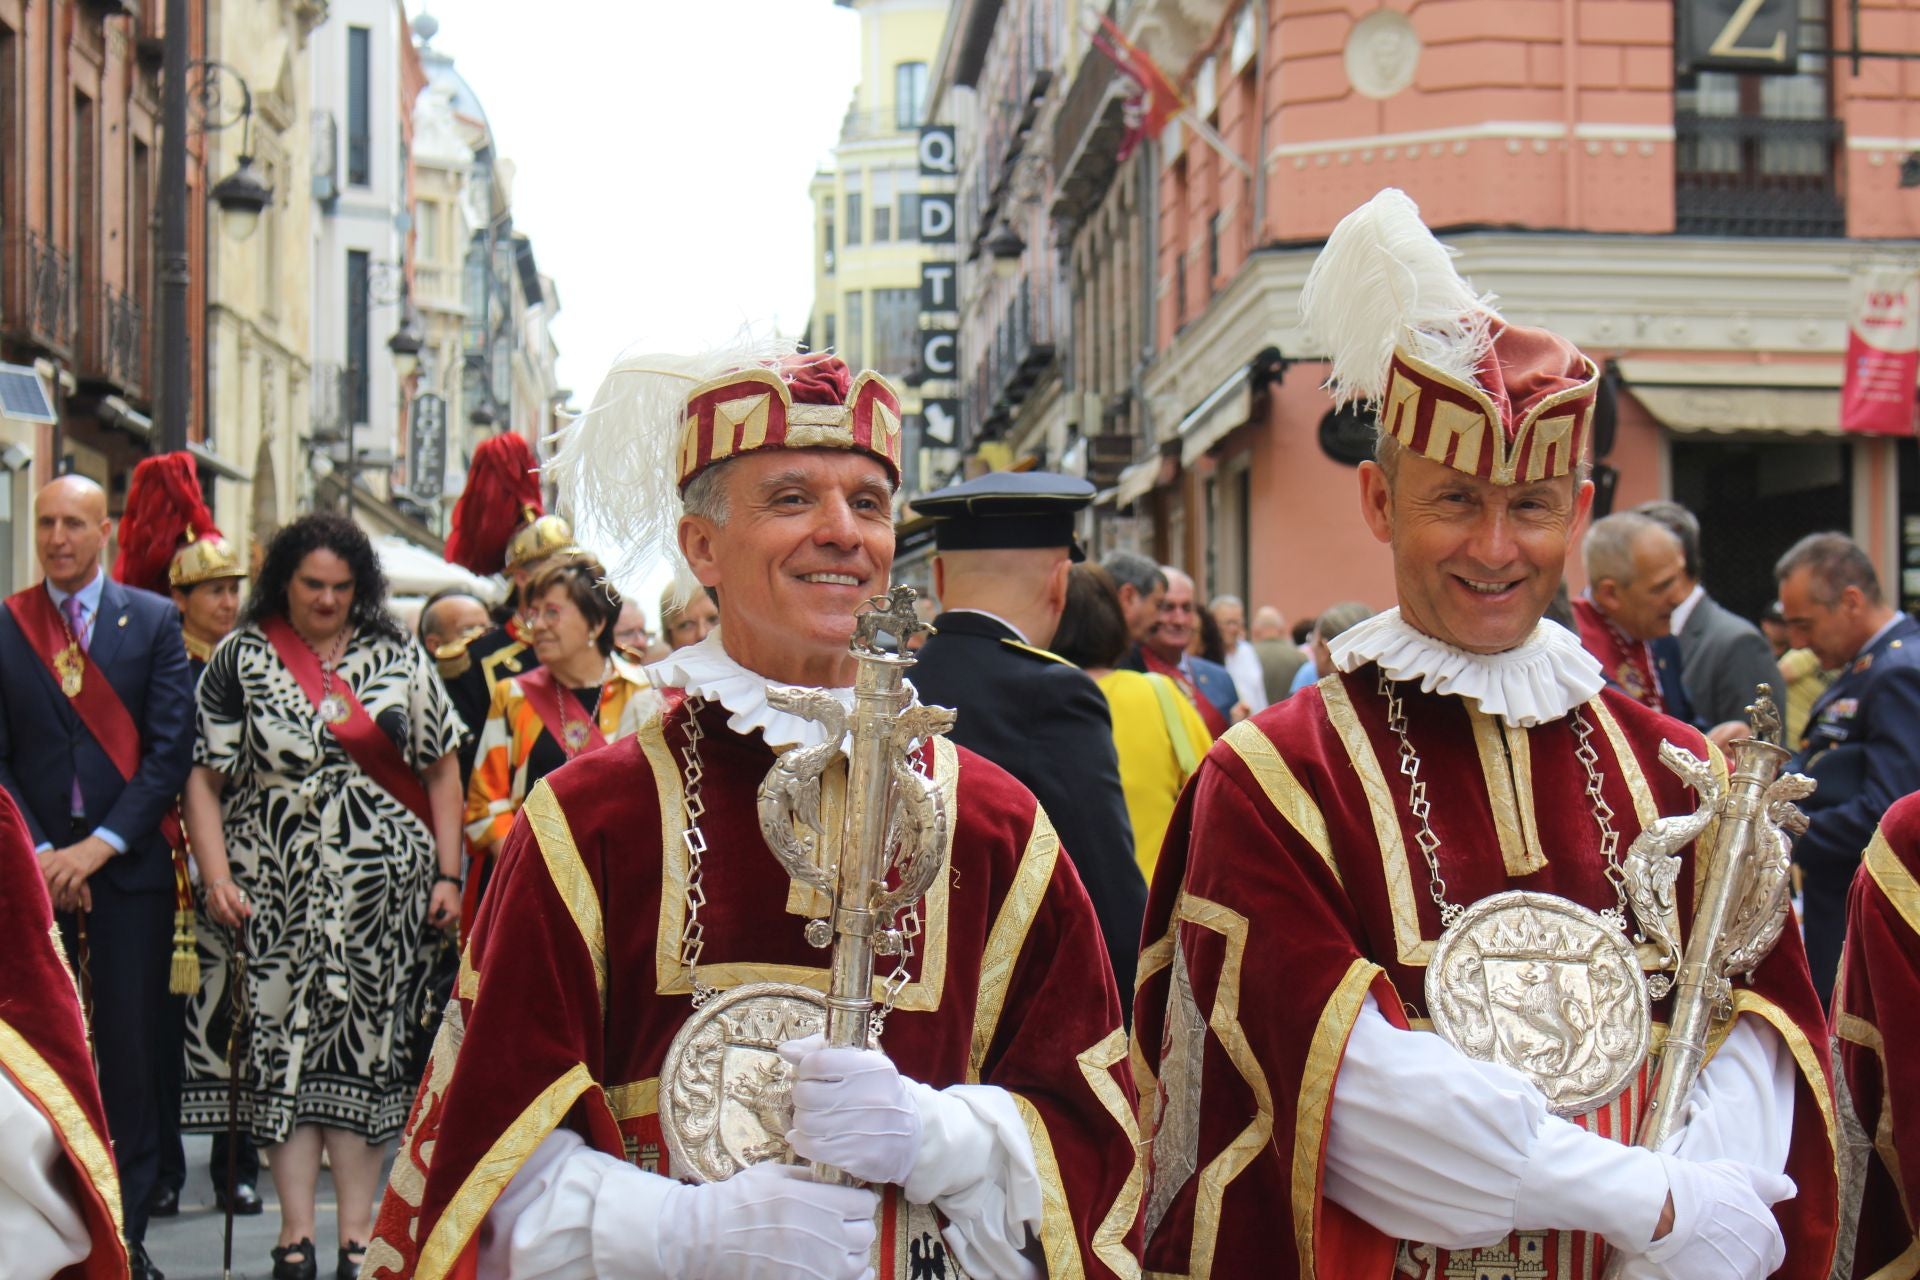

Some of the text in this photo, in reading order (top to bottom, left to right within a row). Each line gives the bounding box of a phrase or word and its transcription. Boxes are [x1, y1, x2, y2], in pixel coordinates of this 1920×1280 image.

[1708, 0, 1787, 62] Z
[919, 131, 954, 373] QDTC
[416, 395, 441, 483] HOTEL
